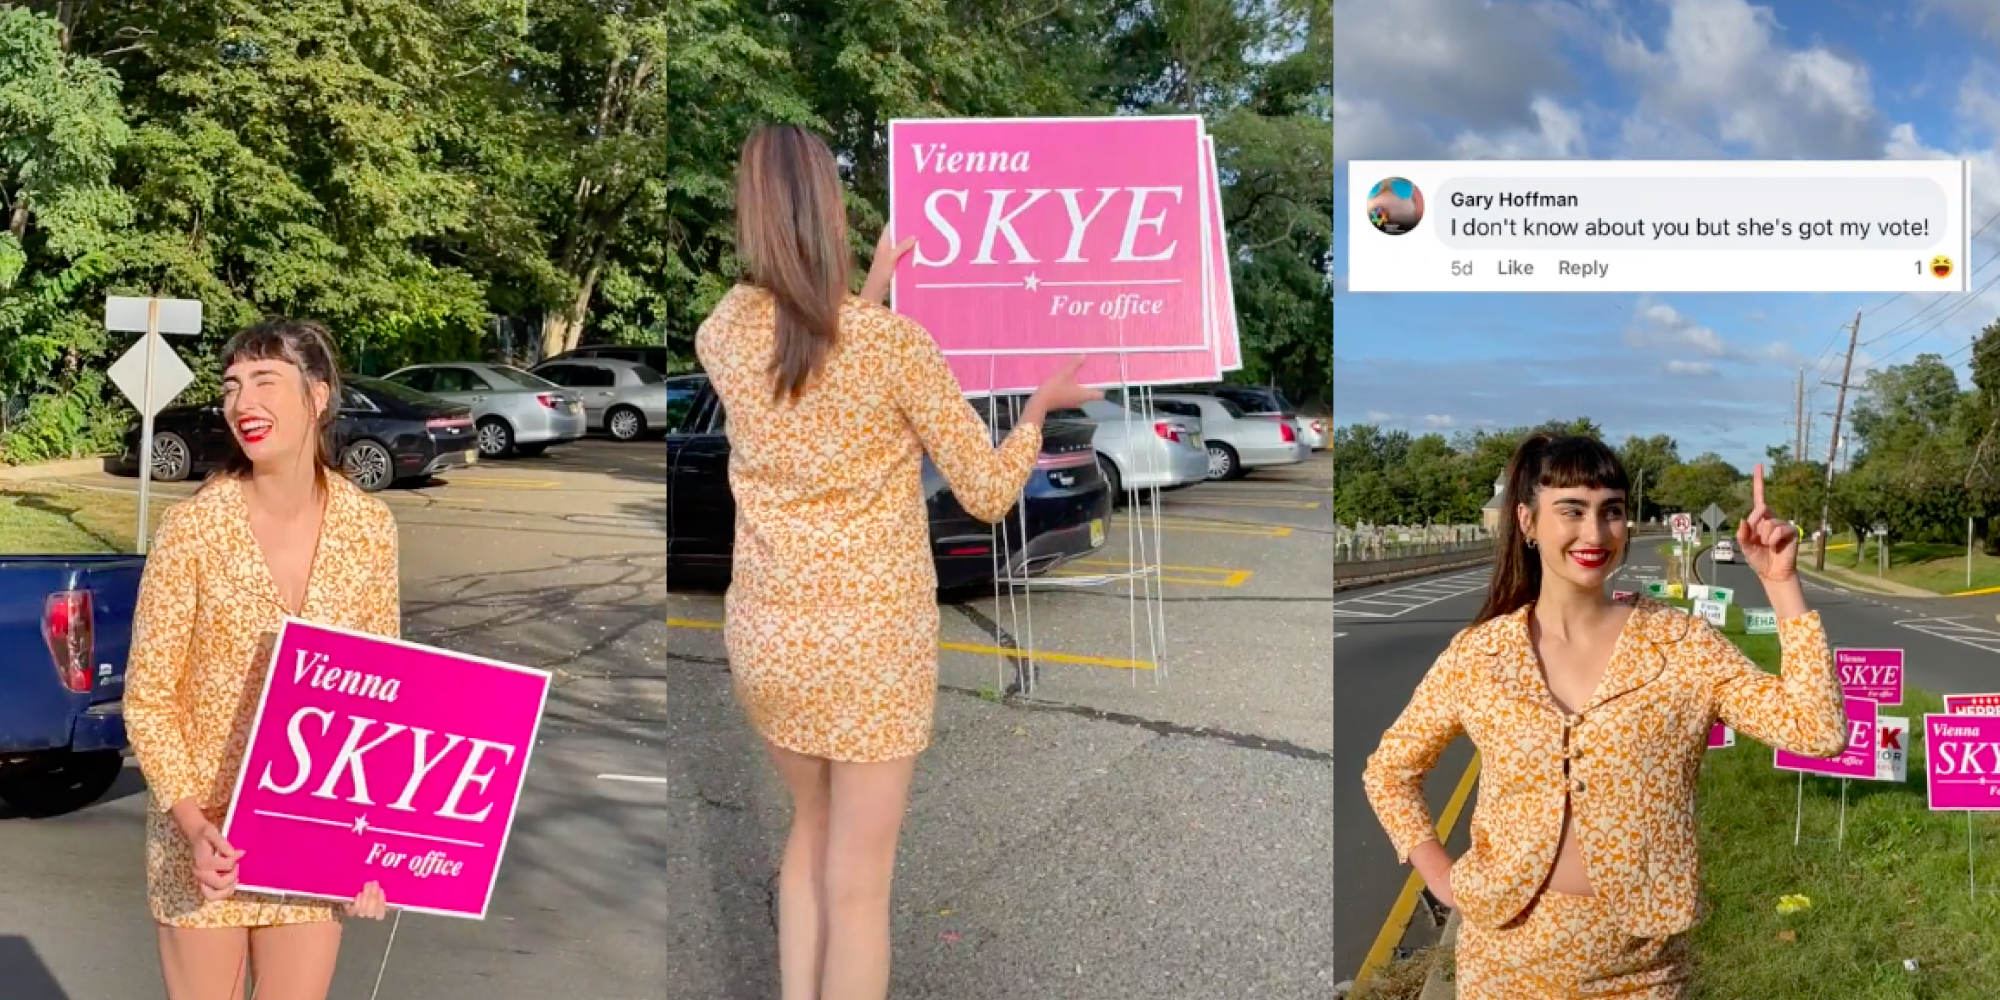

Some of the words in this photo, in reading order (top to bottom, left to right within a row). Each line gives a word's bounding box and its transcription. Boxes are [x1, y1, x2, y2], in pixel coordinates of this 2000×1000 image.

[911, 143, 1031, 173] Vienna
[911, 185, 1183, 268] SKYE
[1049, 295, 1094, 317] For
[1099, 293, 1163, 320] office
[1838, 653, 1867, 663] Vienna
[293, 649, 401, 702] Vienna
[1841, 665, 1899, 685] SKYE
[1933, 722, 1980, 737] Vienna
[257, 706, 516, 822] SKYE
[1842, 755, 1864, 767] office
[365, 842, 406, 868] For
[408, 850, 464, 878] office
